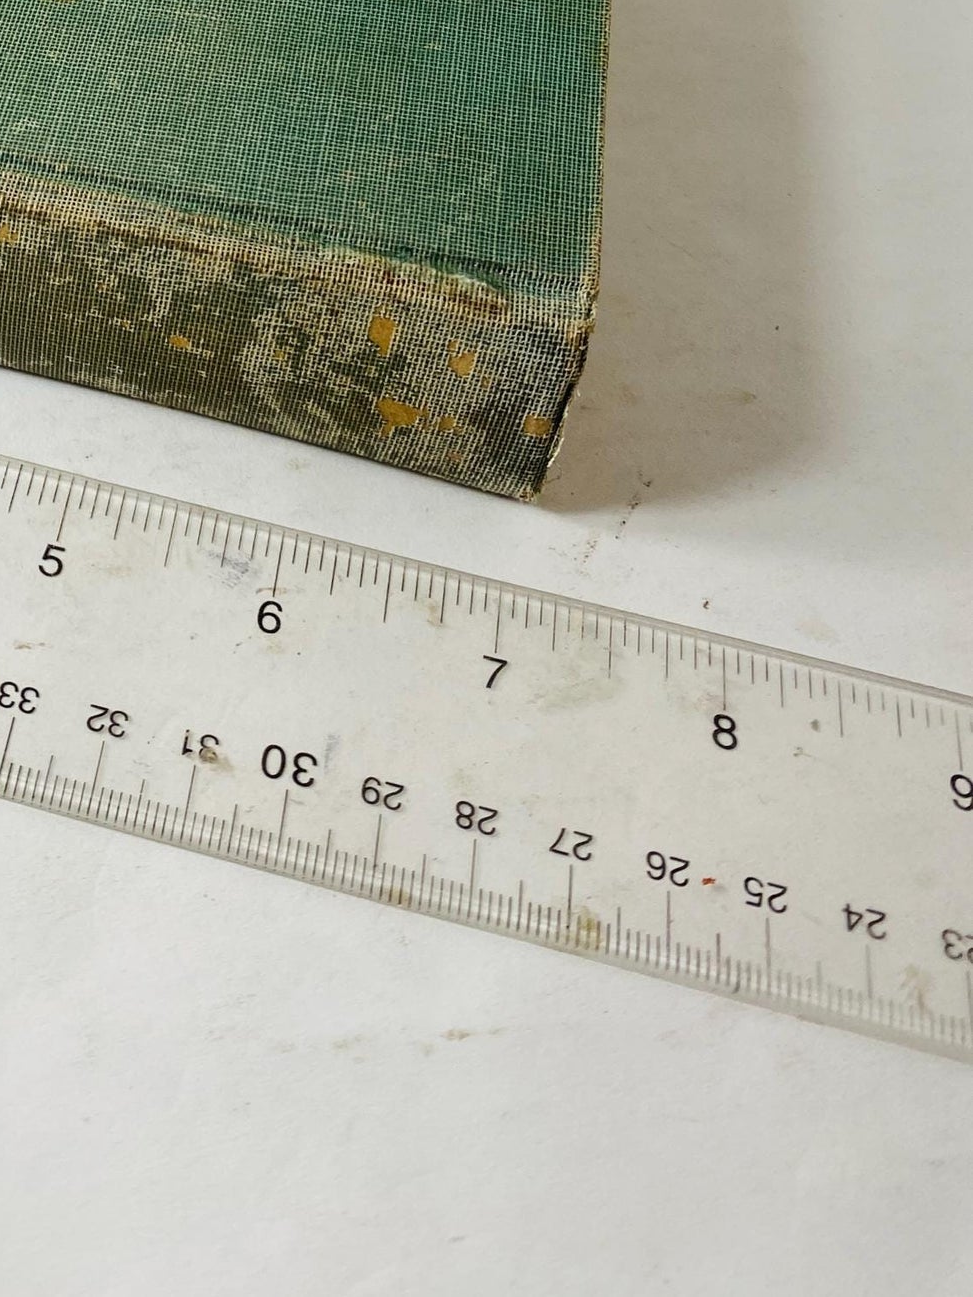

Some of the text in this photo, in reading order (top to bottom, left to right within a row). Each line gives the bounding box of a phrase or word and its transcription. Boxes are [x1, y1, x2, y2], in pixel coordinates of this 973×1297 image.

[38, 543, 67, 578] 5
[256, 600, 283, 635] 6
[482, 654, 509, 689] 7
[711, 713, 739, 751] 8
[949, 773, 973, 812] 9
[86, 703, 130, 739] 32
[181, 729, 220, 764] 31
[260, 744, 319, 788] 30
[360, 776, 405, 812] 29
[455, 800, 499, 836] 28
[548, 827, 594, 862] 27
[645, 850, 691, 888] 26
[743, 876, 788, 914] 25
[841, 903, 887, 941] 24
